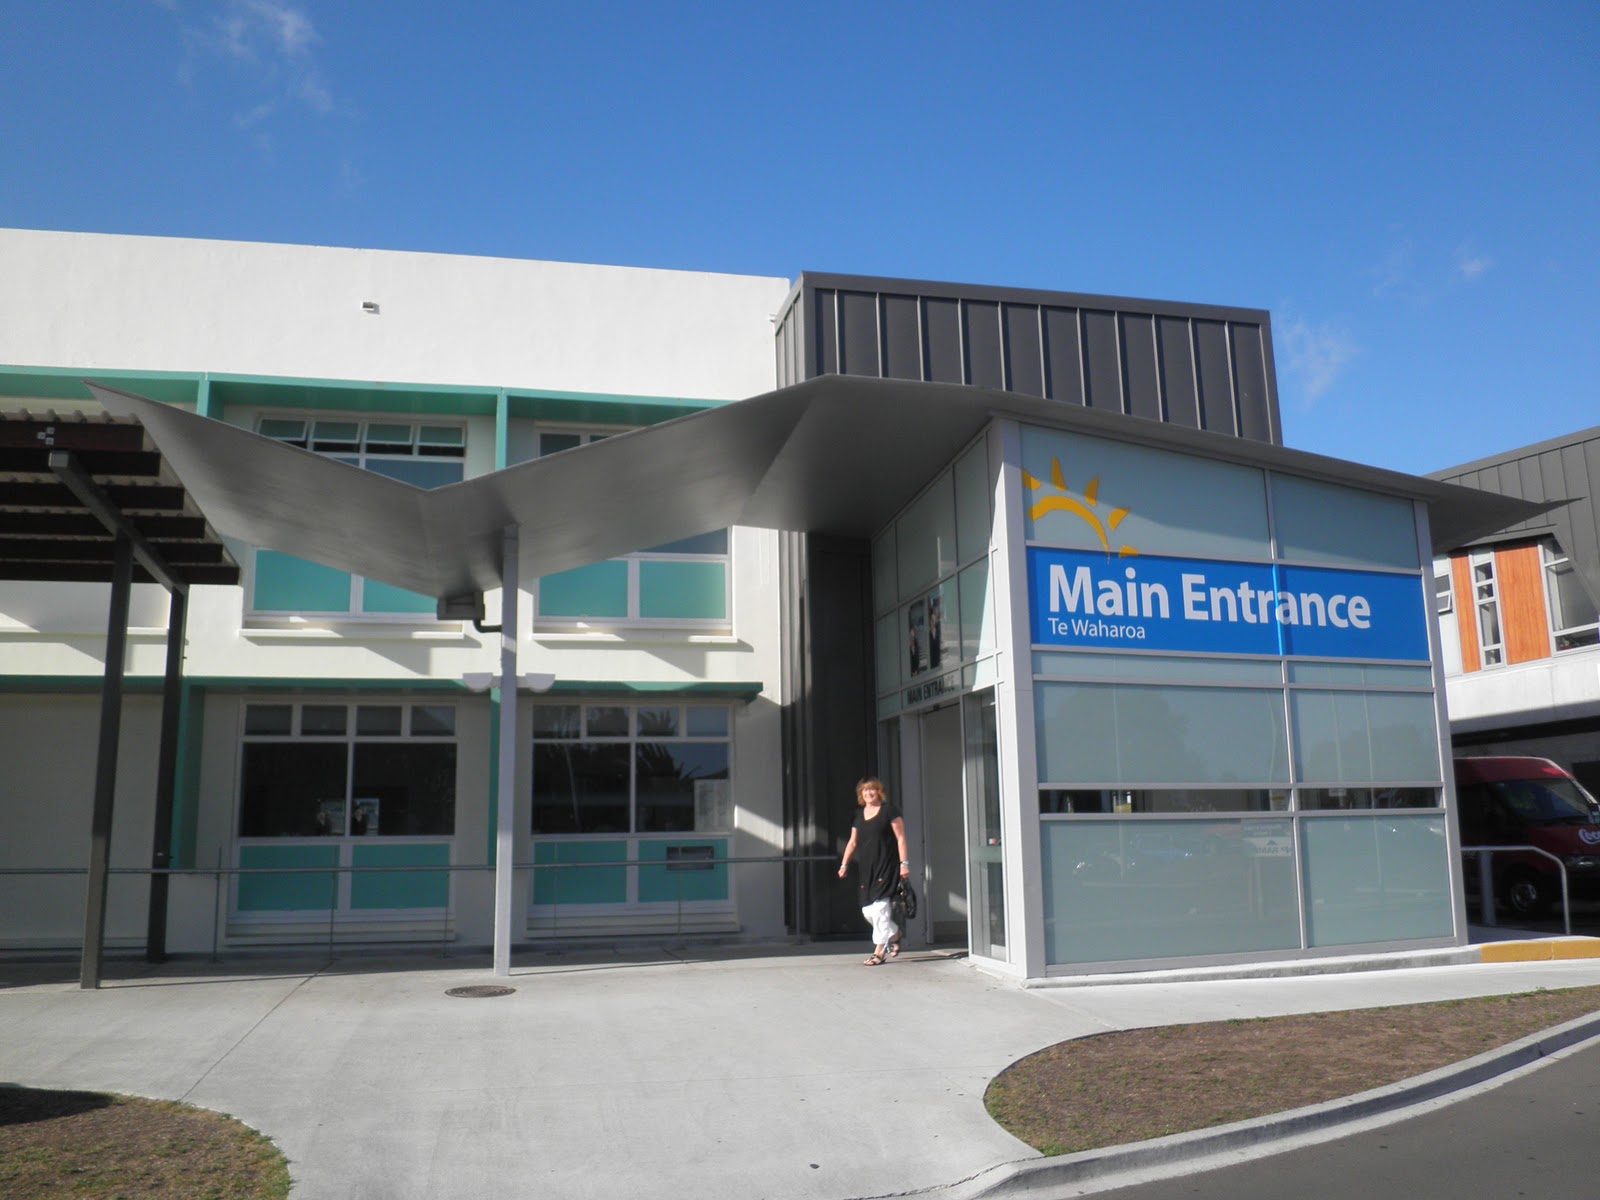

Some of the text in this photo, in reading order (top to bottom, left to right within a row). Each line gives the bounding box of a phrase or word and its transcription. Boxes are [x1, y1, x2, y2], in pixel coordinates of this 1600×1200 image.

[1049, 564, 1371, 629] Main Entrance
[1048, 617, 1146, 639] Te Waharoa
[907, 687, 922, 705] MAIN
